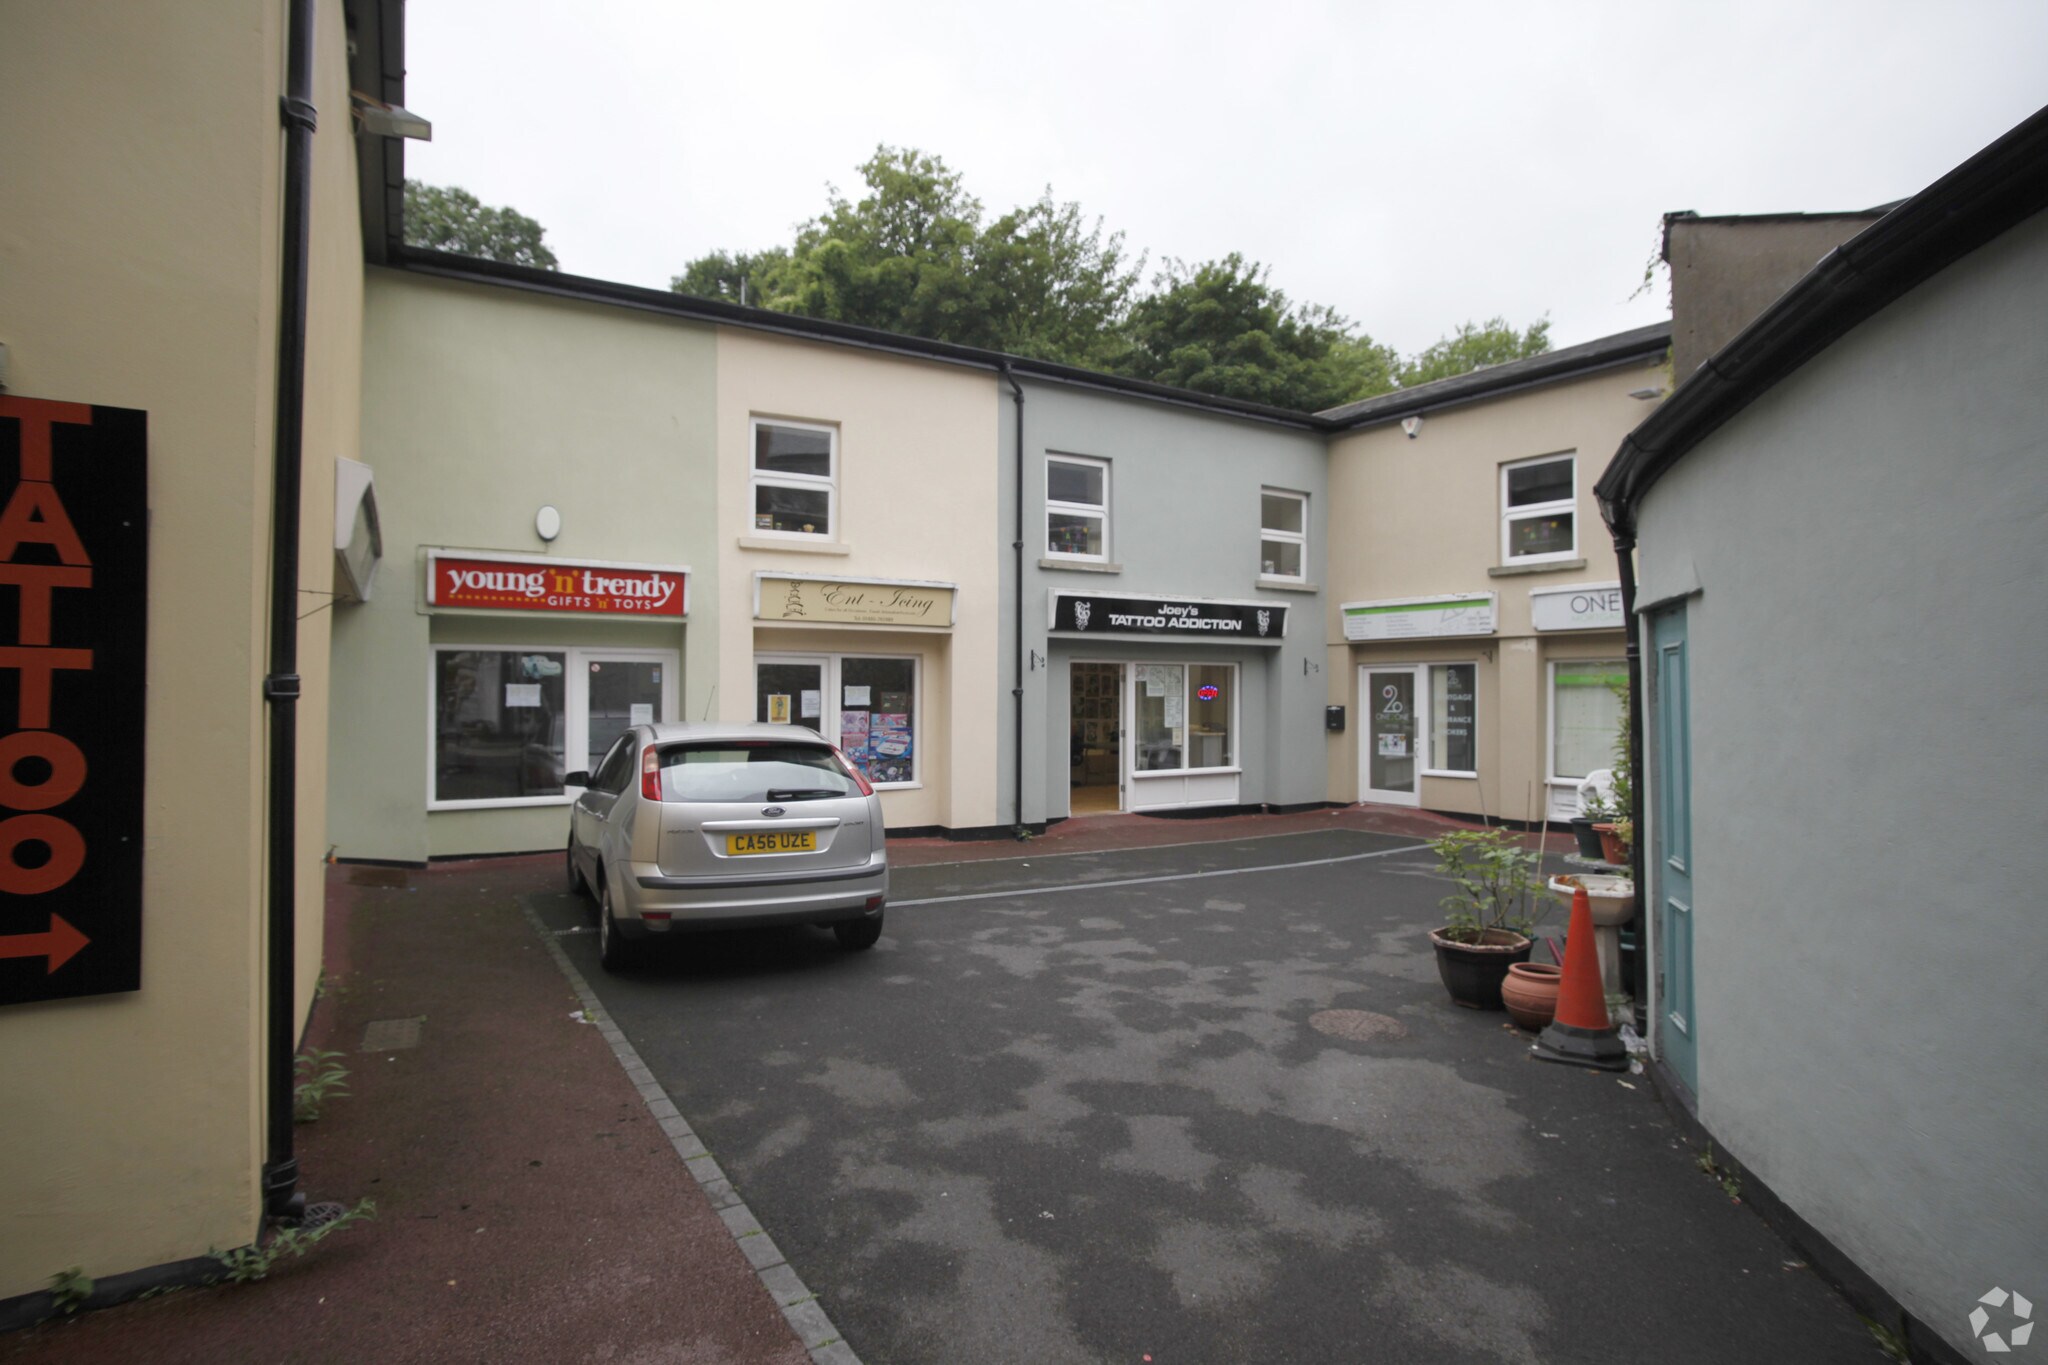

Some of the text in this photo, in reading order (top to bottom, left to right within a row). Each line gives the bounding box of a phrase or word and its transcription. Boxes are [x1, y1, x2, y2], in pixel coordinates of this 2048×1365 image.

[447, 569, 547, 597] young
[582, 570, 676, 608] trendy
[547, 596, 591, 608] GIFTS
[614, 598, 651, 610] TOYS
[820, 583, 865, 606] Ent
[880, 587, 934, 616] Icing
[1570, 592, 1620, 614] ONE
[1157, 604, 1199, 616] Joey's
[1109, 614, 1242, 630] TATTOO ADDICTION
[0, 395, 93, 895] TATTOO
[735, 832, 810, 851] CA56 UZE
